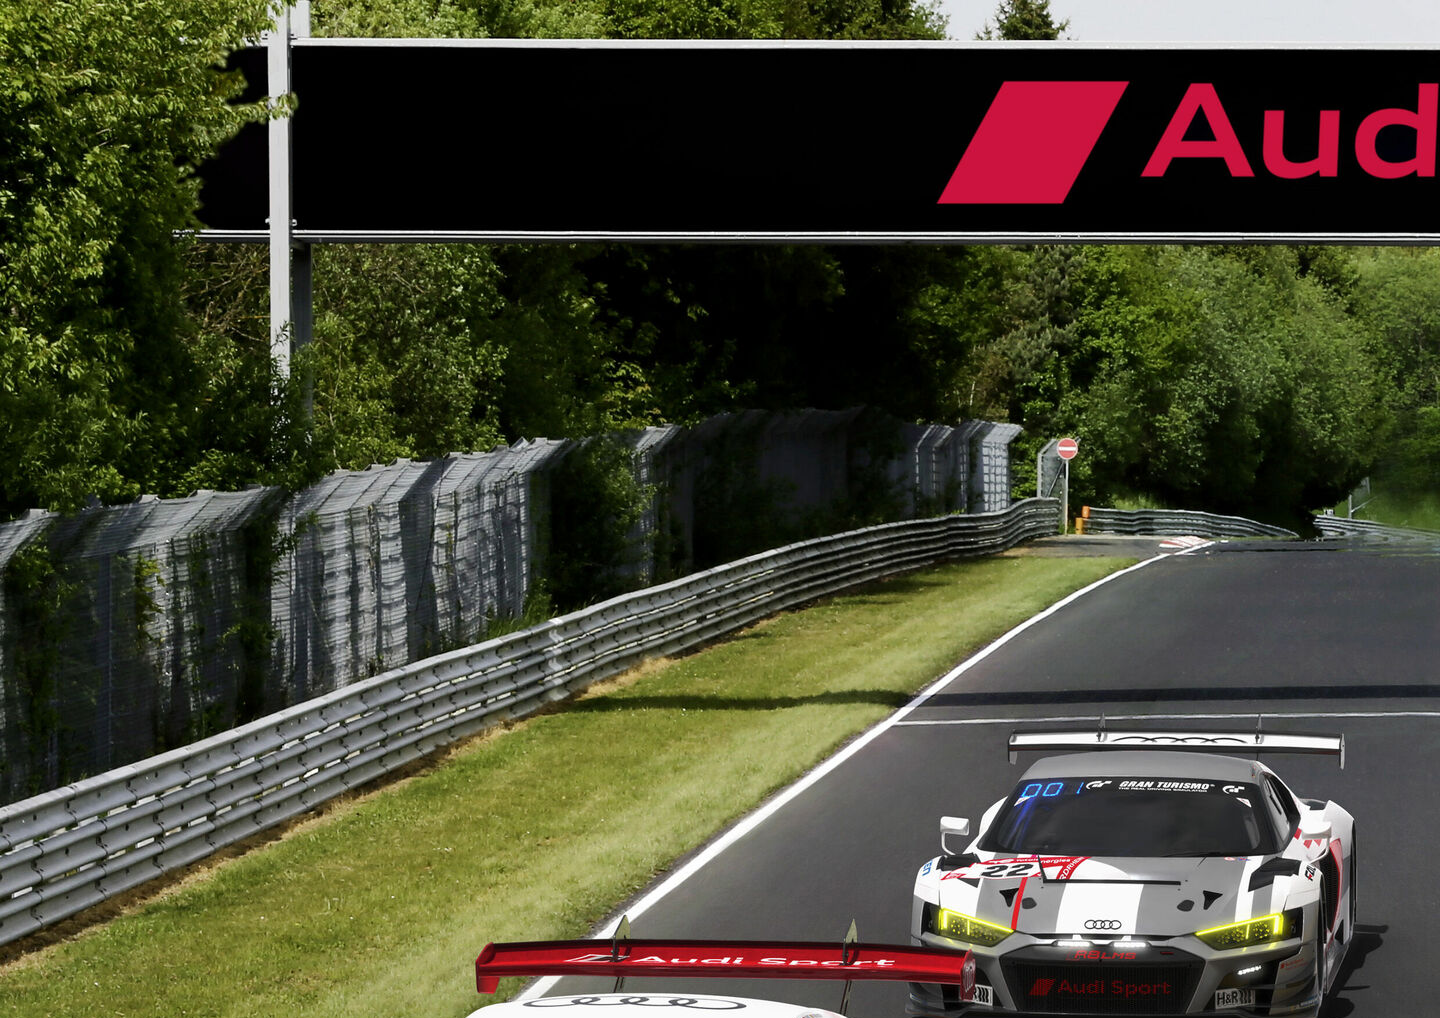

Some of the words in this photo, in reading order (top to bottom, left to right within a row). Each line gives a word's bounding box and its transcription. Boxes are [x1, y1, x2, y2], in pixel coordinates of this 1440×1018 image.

[1119, 780, 1154, 788] GRAN
[981, 863, 1034, 878] 22
[632, 955, 745, 965] Audi
[758, 957, 895, 967] Sport
[1058, 980, 1105, 994] Audi
[1111, 980, 1172, 998] Sport
[1216, 991, 1239, 1006] H&R
